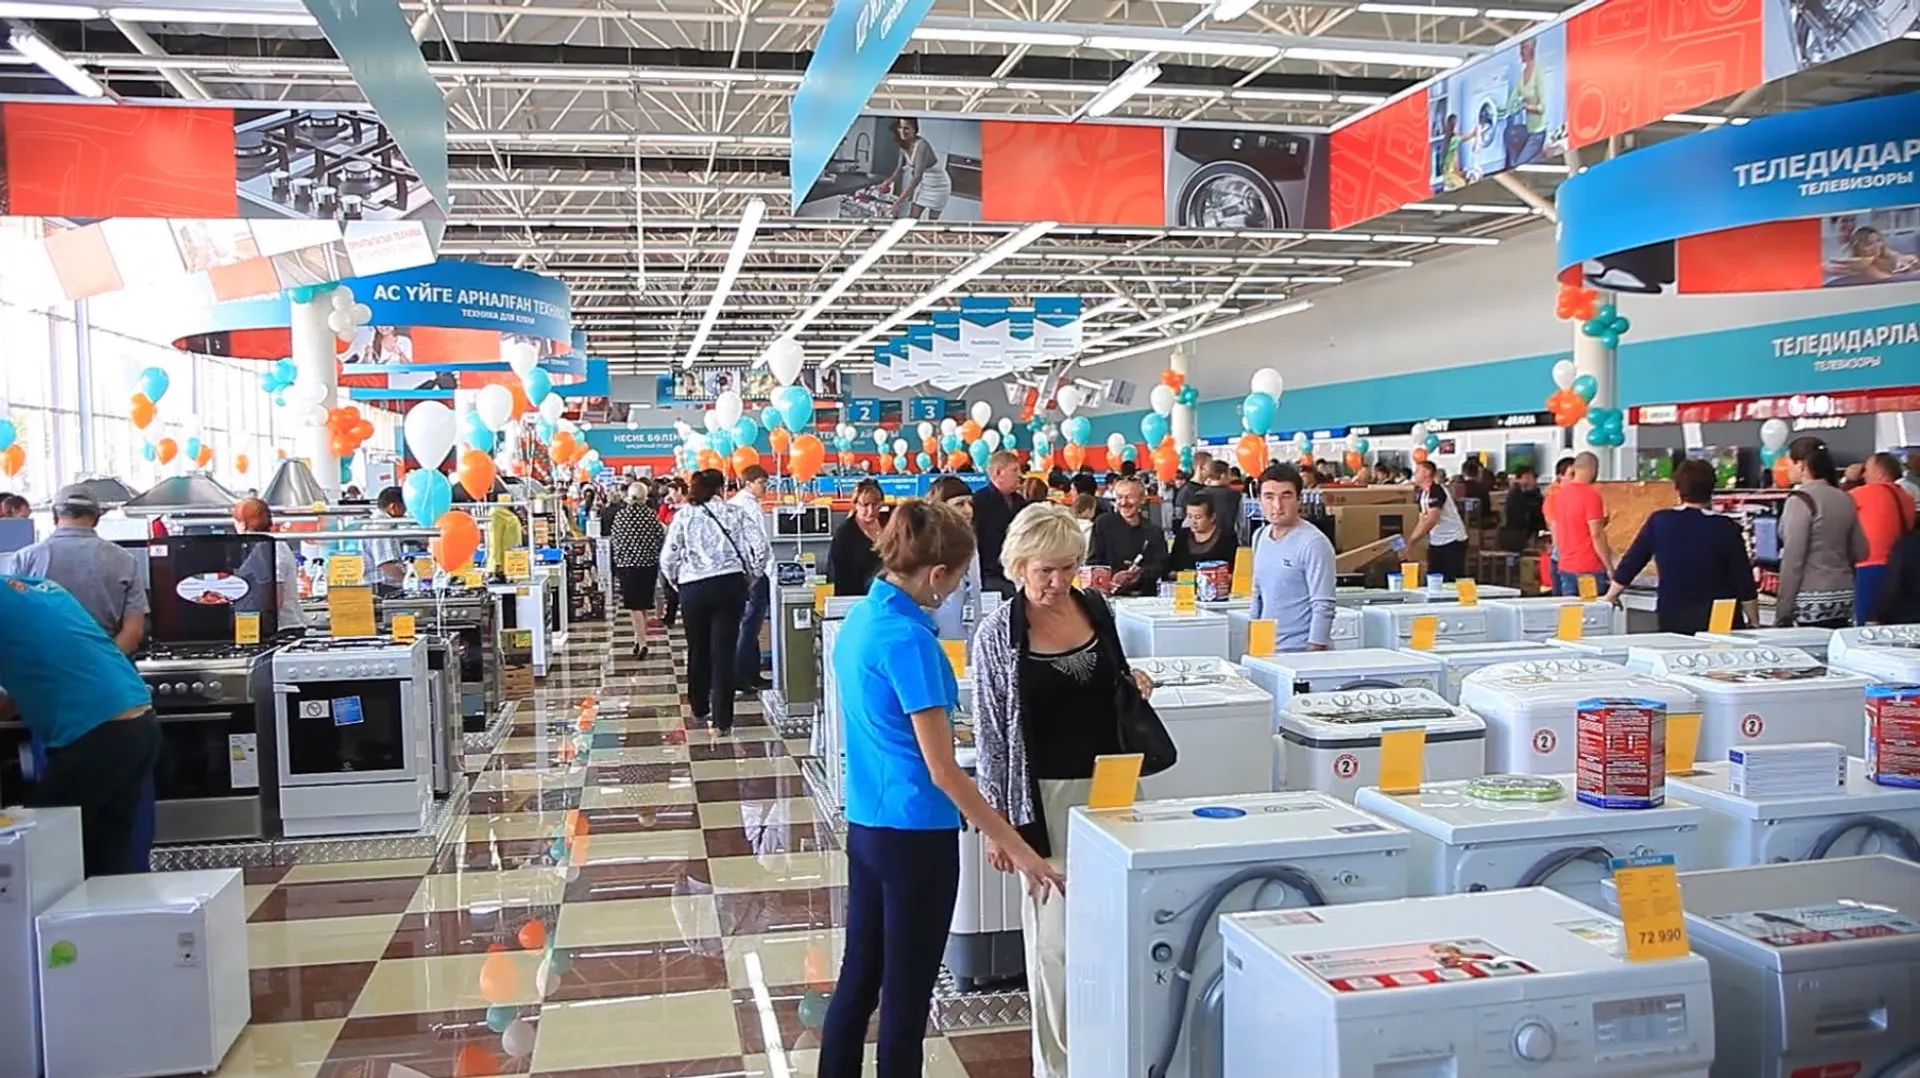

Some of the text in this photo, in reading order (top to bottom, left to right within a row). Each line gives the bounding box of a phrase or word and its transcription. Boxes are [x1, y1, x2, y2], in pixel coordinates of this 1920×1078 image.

[1733, 139, 1920, 188] ТЕЛЕДИДАР
[1798, 171, 1914, 197] ТЕЛЕВИЗОРЫ
[373, 285, 401, 301] АС
[405, 283, 453, 303] ҮЙГЕ
[457, 290, 532, 313] АРНАЛҒАН
[1771, 322, 1920, 358] ТЕЛЕДИДАРЛА
[860, 406, 871, 420] 2
[924, 405, 936, 419] 3
[1748, 720, 1756, 732] 2
[1540, 735, 1549, 748] 2
[1342, 760, 1350, 773] 2
[1638, 927, 1682, 945] 72 990
